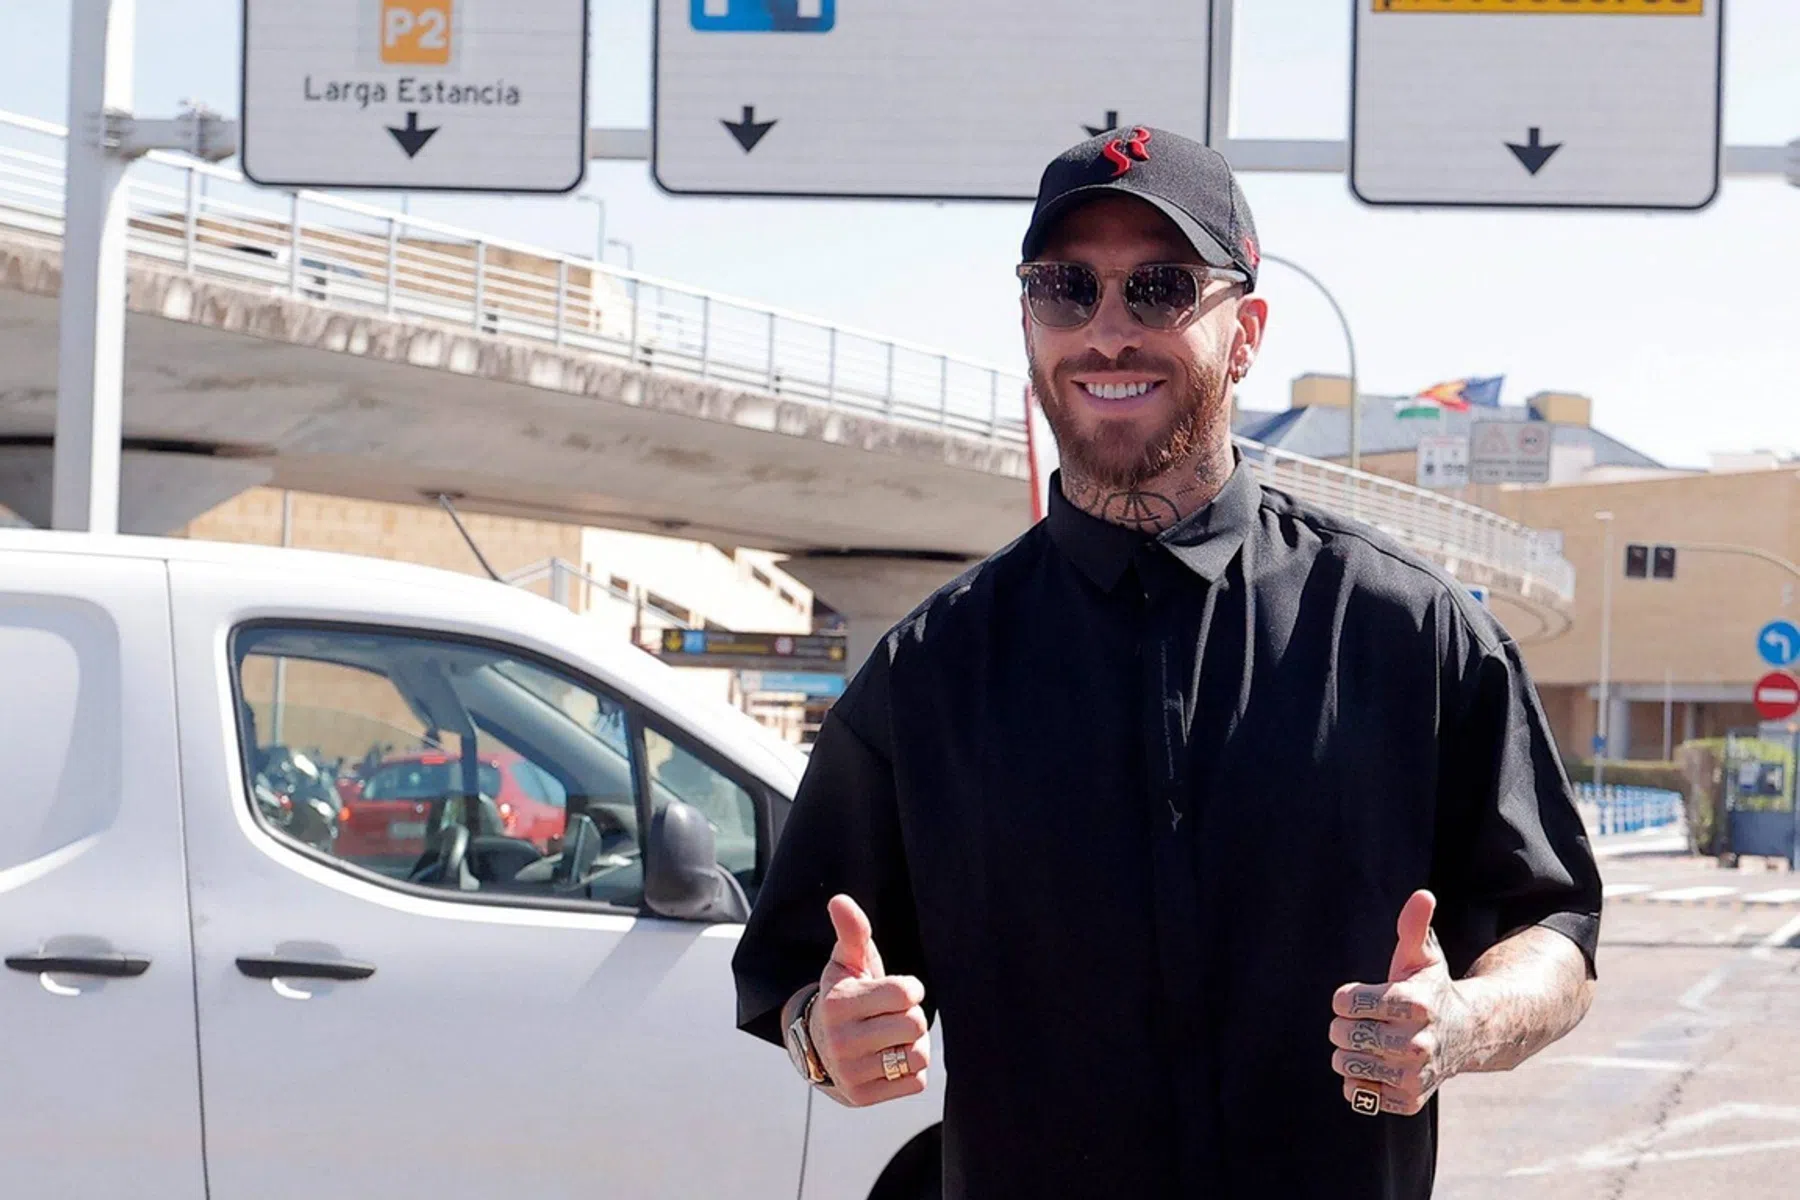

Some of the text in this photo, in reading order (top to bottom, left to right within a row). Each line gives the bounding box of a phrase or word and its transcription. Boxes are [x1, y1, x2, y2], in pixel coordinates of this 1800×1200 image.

[384, 8, 448, 48] P2
[303, 75, 521, 108] Larga Estancia
